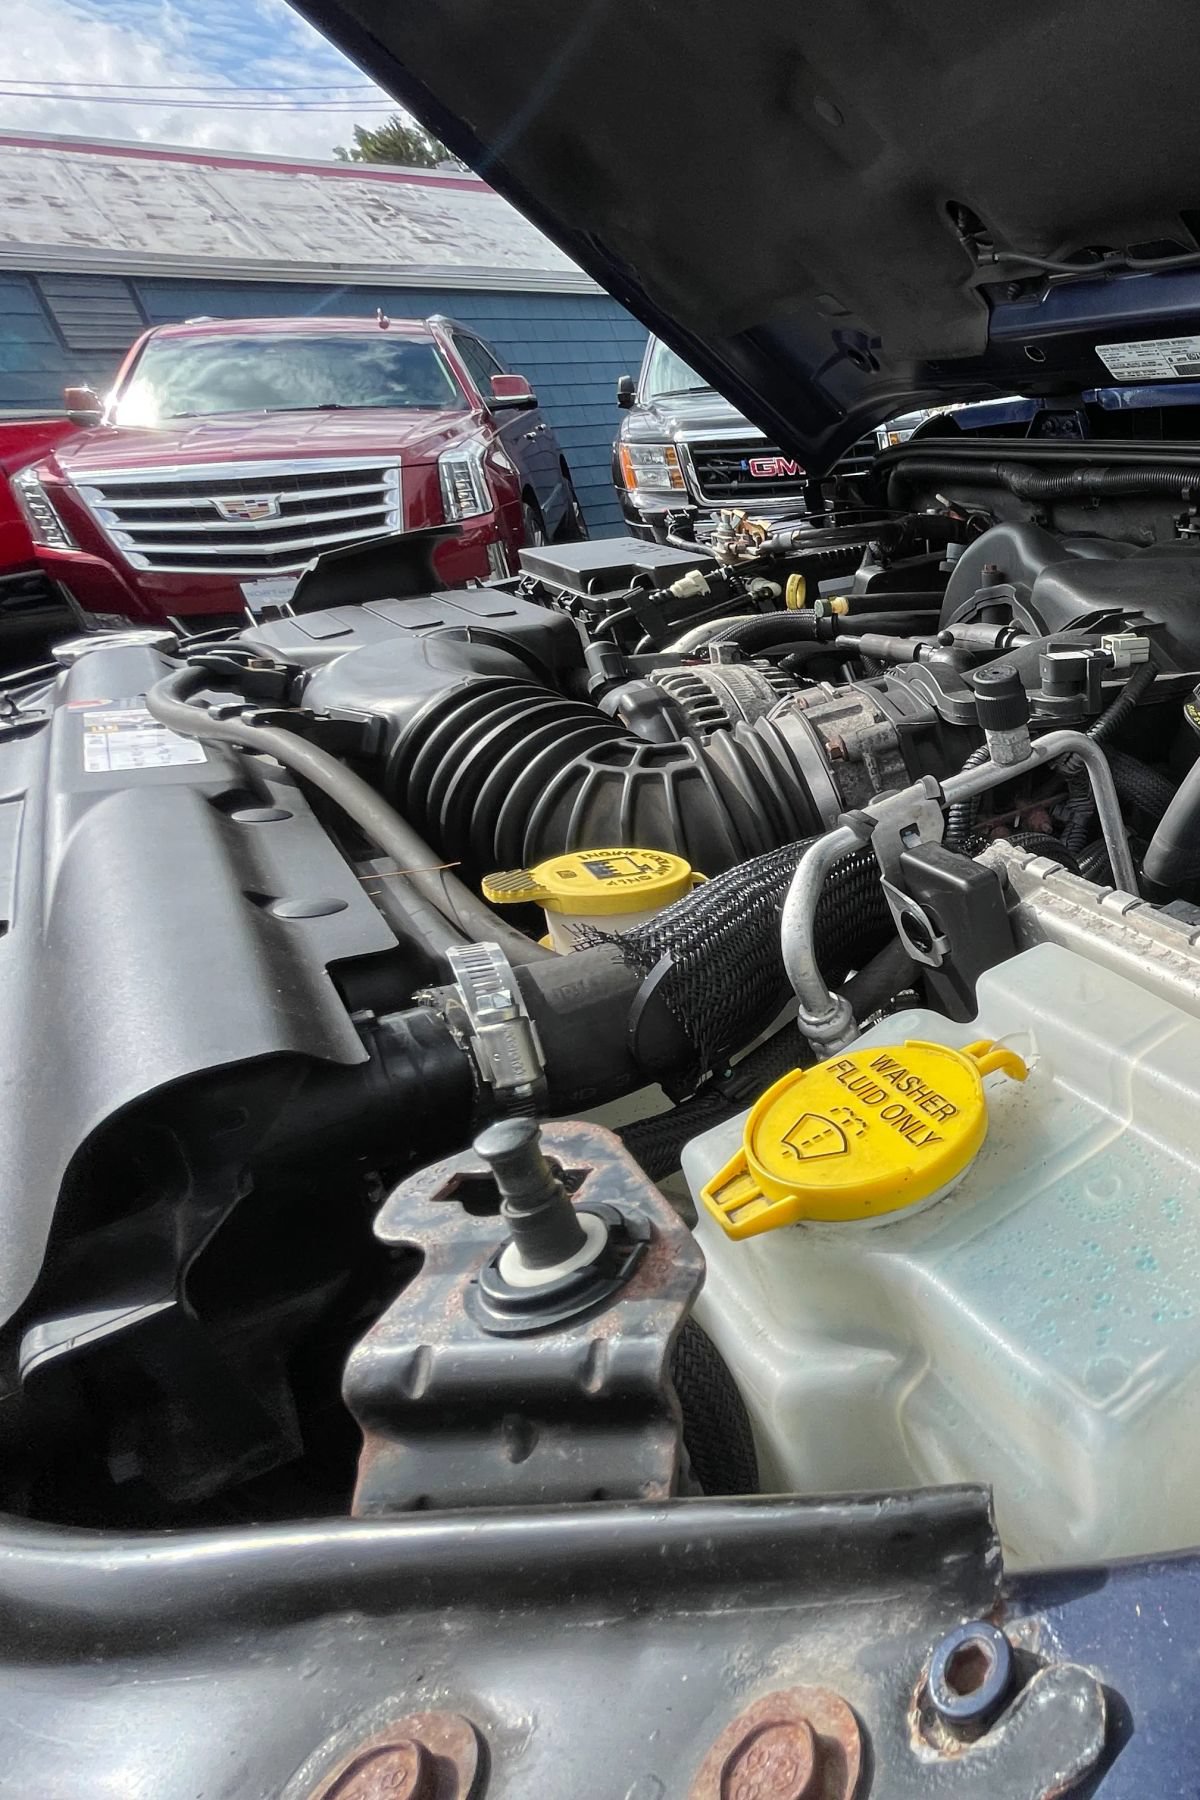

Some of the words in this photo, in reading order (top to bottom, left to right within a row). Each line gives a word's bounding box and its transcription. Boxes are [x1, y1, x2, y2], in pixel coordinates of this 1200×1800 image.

[748, 457, 807, 477] GM
[577, 850, 639, 861] ENGINE
[606, 875, 653, 886] ONLY
[869, 1053, 957, 1122] WASHER
[826, 1059, 887, 1105] FLUID
[880, 1103, 943, 1148] ONLY
